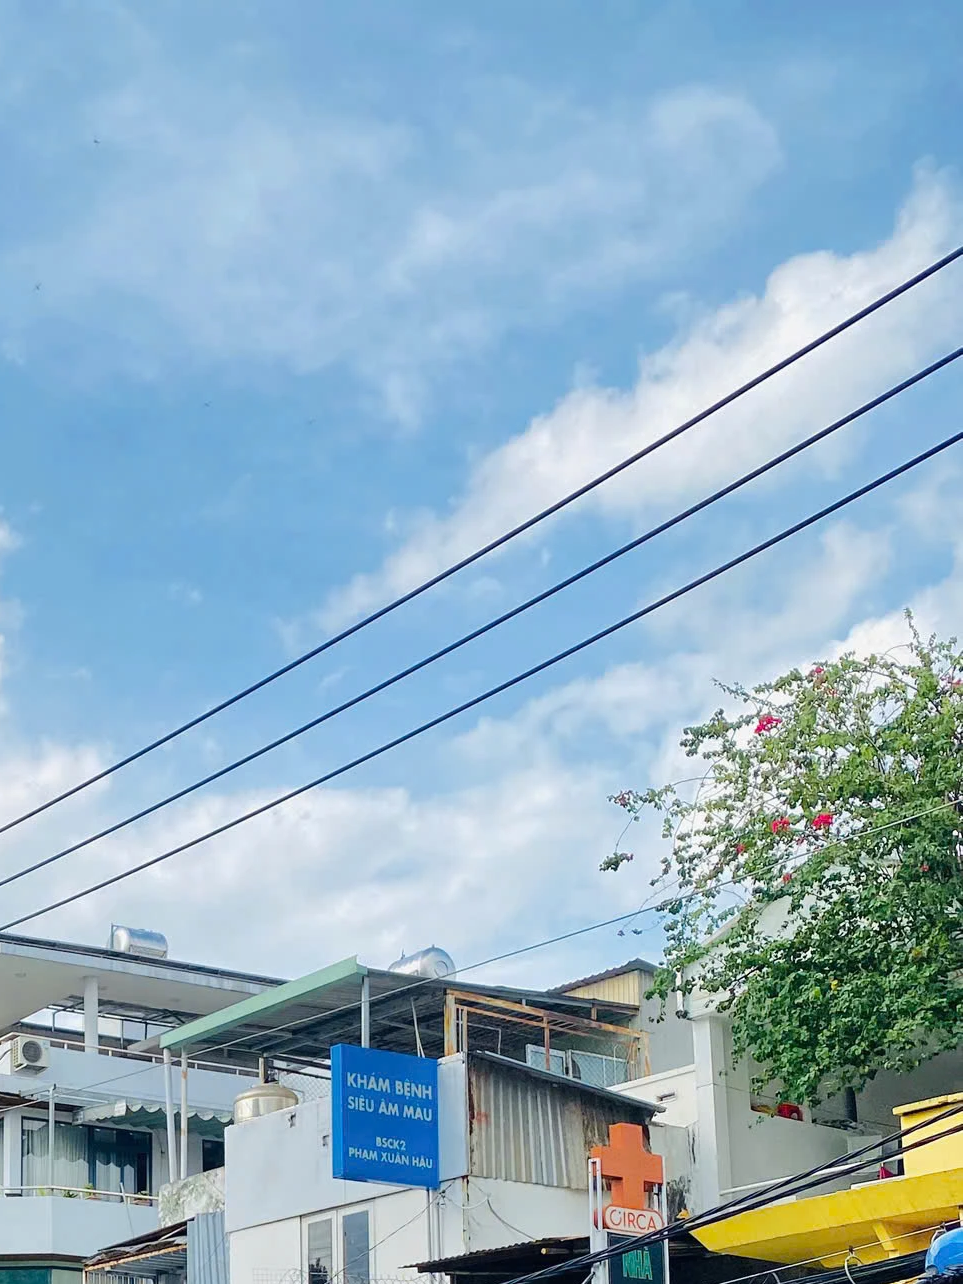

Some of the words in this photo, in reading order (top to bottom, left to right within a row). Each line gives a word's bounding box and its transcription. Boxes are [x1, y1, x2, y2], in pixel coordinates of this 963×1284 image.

[346, 1072, 390, 1093] KHÁM
[395, 1078, 433, 1101] BỆNH
[347, 1094, 374, 1112] SIÊU
[378, 1098, 399, 1117] ÂM
[375, 1136, 406, 1151] BSCK2
[348, 1146, 378, 1162] PHẠM
[381, 1150, 409, 1166] XUÂN
[412, 1155, 433, 1170] HẬU
[609, 1209, 657, 1231] CIRCA
[622, 1247, 653, 1280] NHÀ
